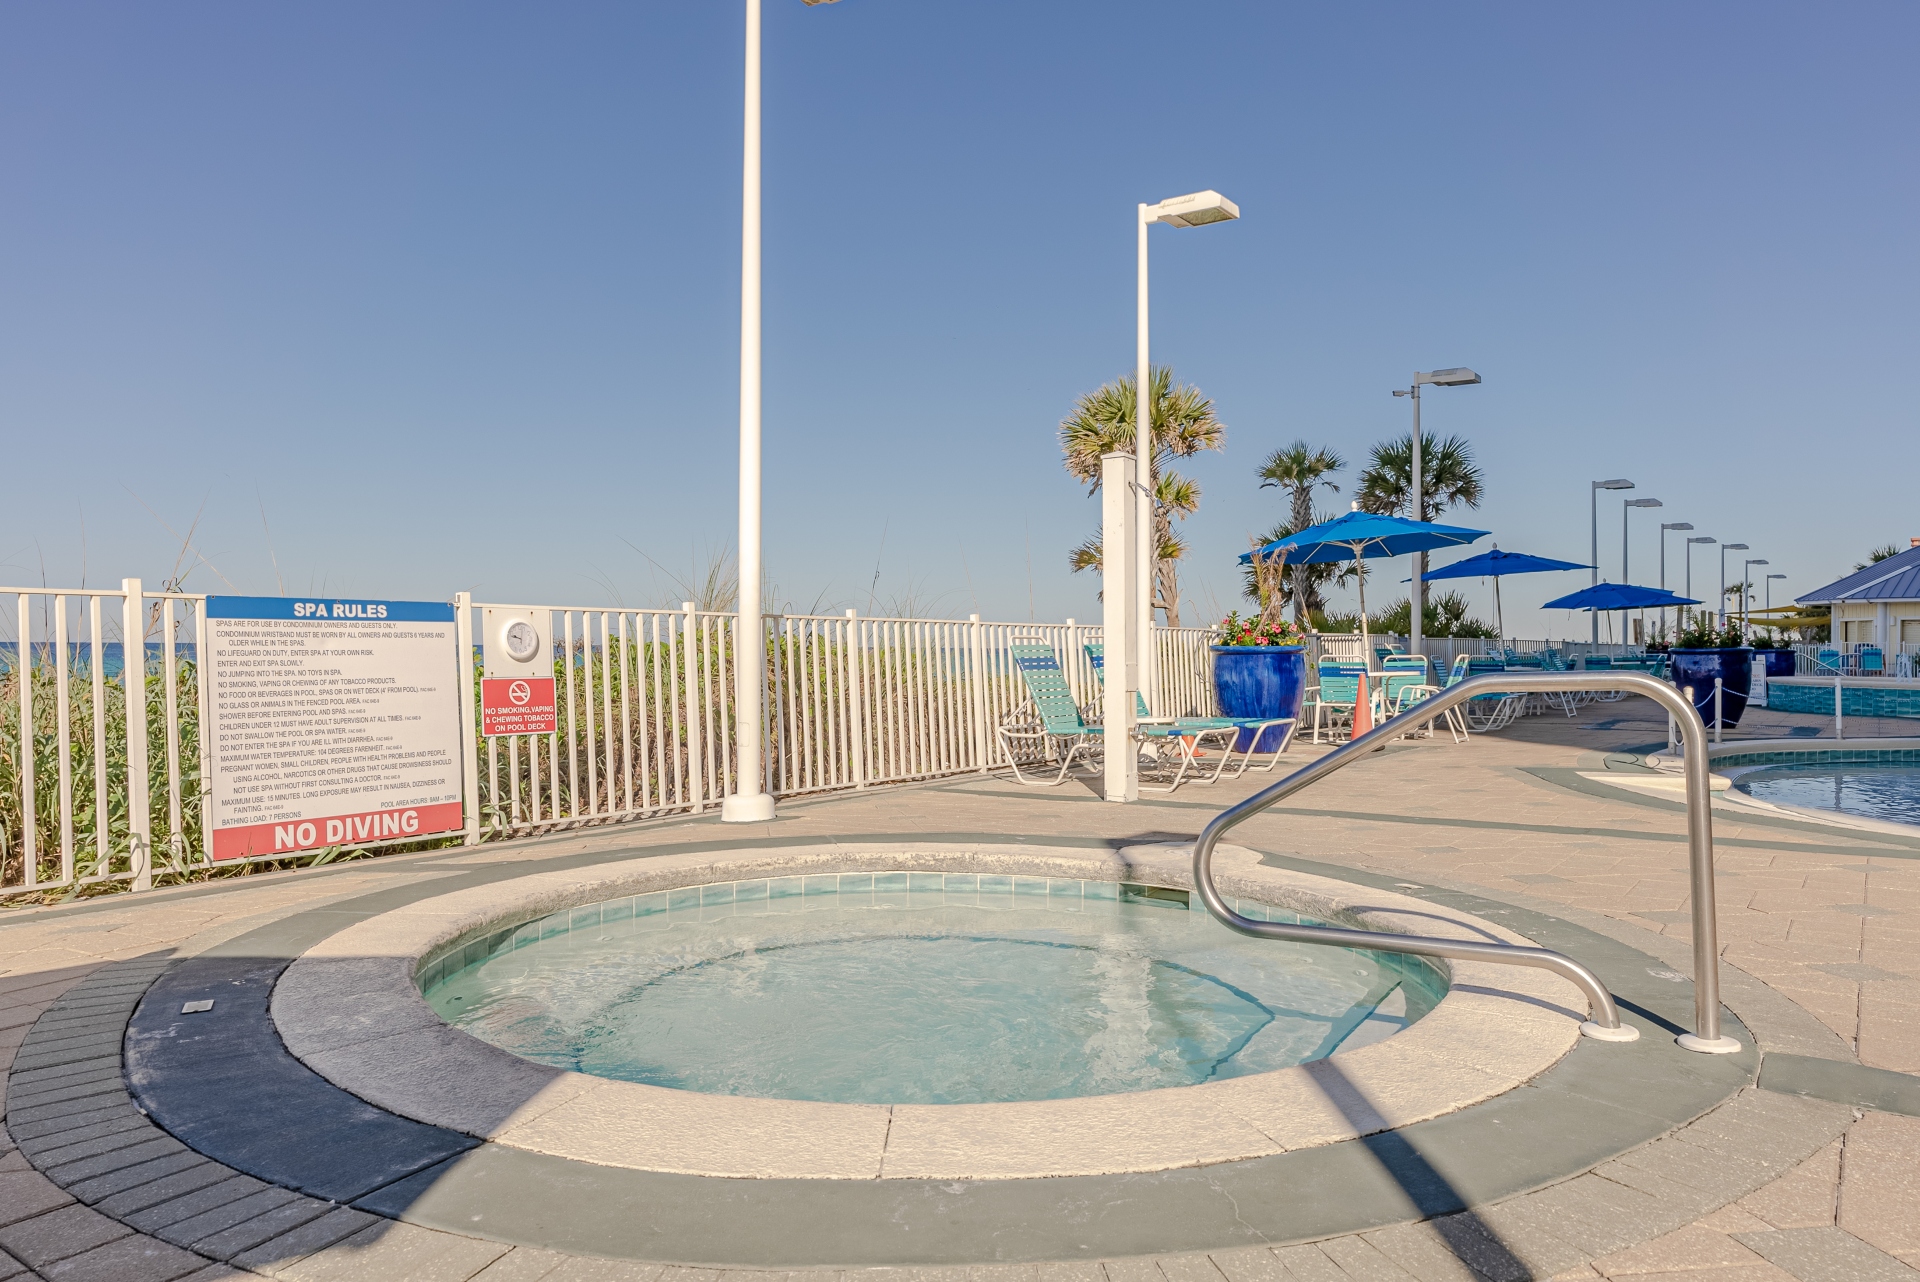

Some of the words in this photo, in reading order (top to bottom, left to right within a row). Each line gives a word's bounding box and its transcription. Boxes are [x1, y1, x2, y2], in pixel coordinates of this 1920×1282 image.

[294, 602, 328, 617] SPA
[333, 604, 387, 618] RULES
[221, 764, 254, 773] PREGNANT
[284, 770, 316, 778] NARCOTICS
[319, 778, 353, 786] CONSULTING
[222, 797, 251, 806] MAXIMUM
[320, 788, 349, 796] EXPOSURE
[222, 817, 248, 826] BATHING
[274, 811, 301, 820] PERSONS
[275, 822, 317, 850] NO
[326, 810, 418, 843] DIVING
